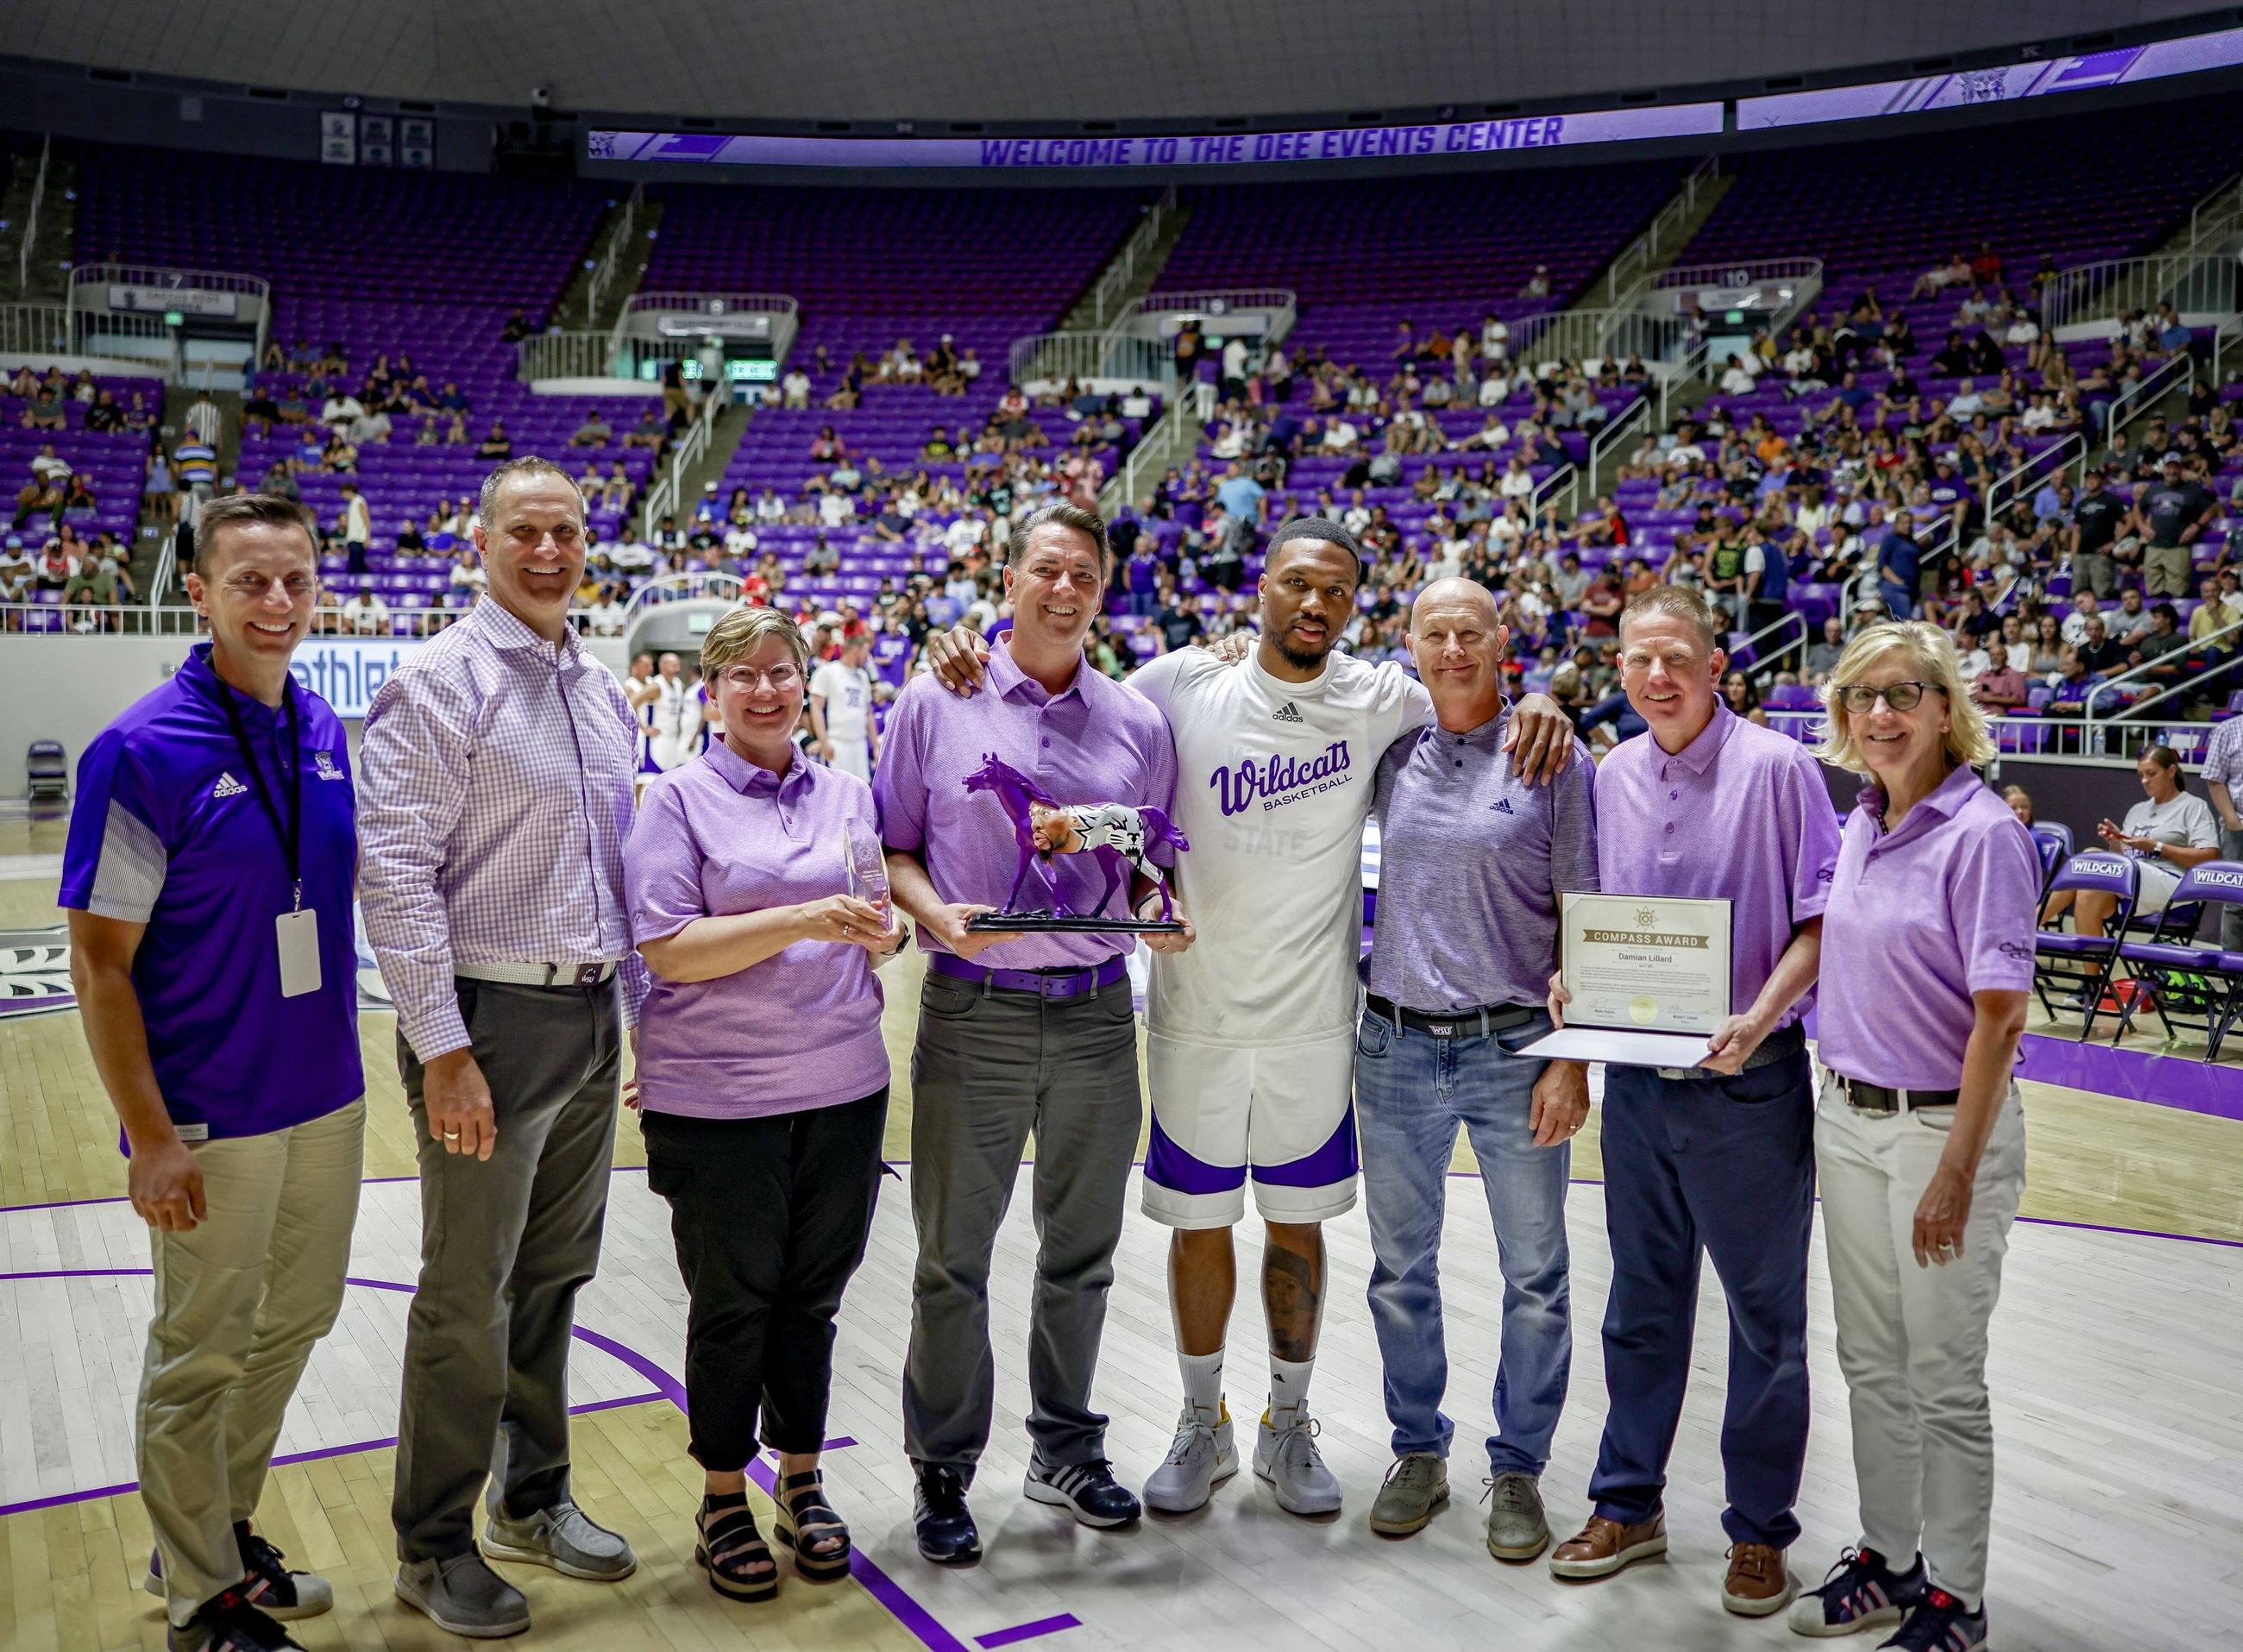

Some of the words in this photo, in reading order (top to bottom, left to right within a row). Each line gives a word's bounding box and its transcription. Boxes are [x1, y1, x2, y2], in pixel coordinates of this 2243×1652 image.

[980, 139, 1133, 166] WELCOME
[1143, 139, 1178, 164] TO
[1189, 136, 1245, 162] THE
[1253, 133, 1312, 160] DEE
[1321, 126, 1437, 159] EVENTS
[1445, 116, 1565, 152] CENTER
[1726, 269, 1750, 287] 10
[1272, 713, 1304, 723] adidas
[1209, 740, 1351, 817] Wildcats
[214, 784, 248, 798] adidas
[1263, 774, 1353, 811] BASKETBALL
[1489, 805, 1513, 815] adidas
[2073, 862, 2123, 876] WILDCATS
[2197, 870, 2243, 886] WILDCAT
[1594, 932, 1651, 944] COMPASS
[1656, 935, 1698, 946] AWARD
[1618, 953, 1647, 962] Damian
